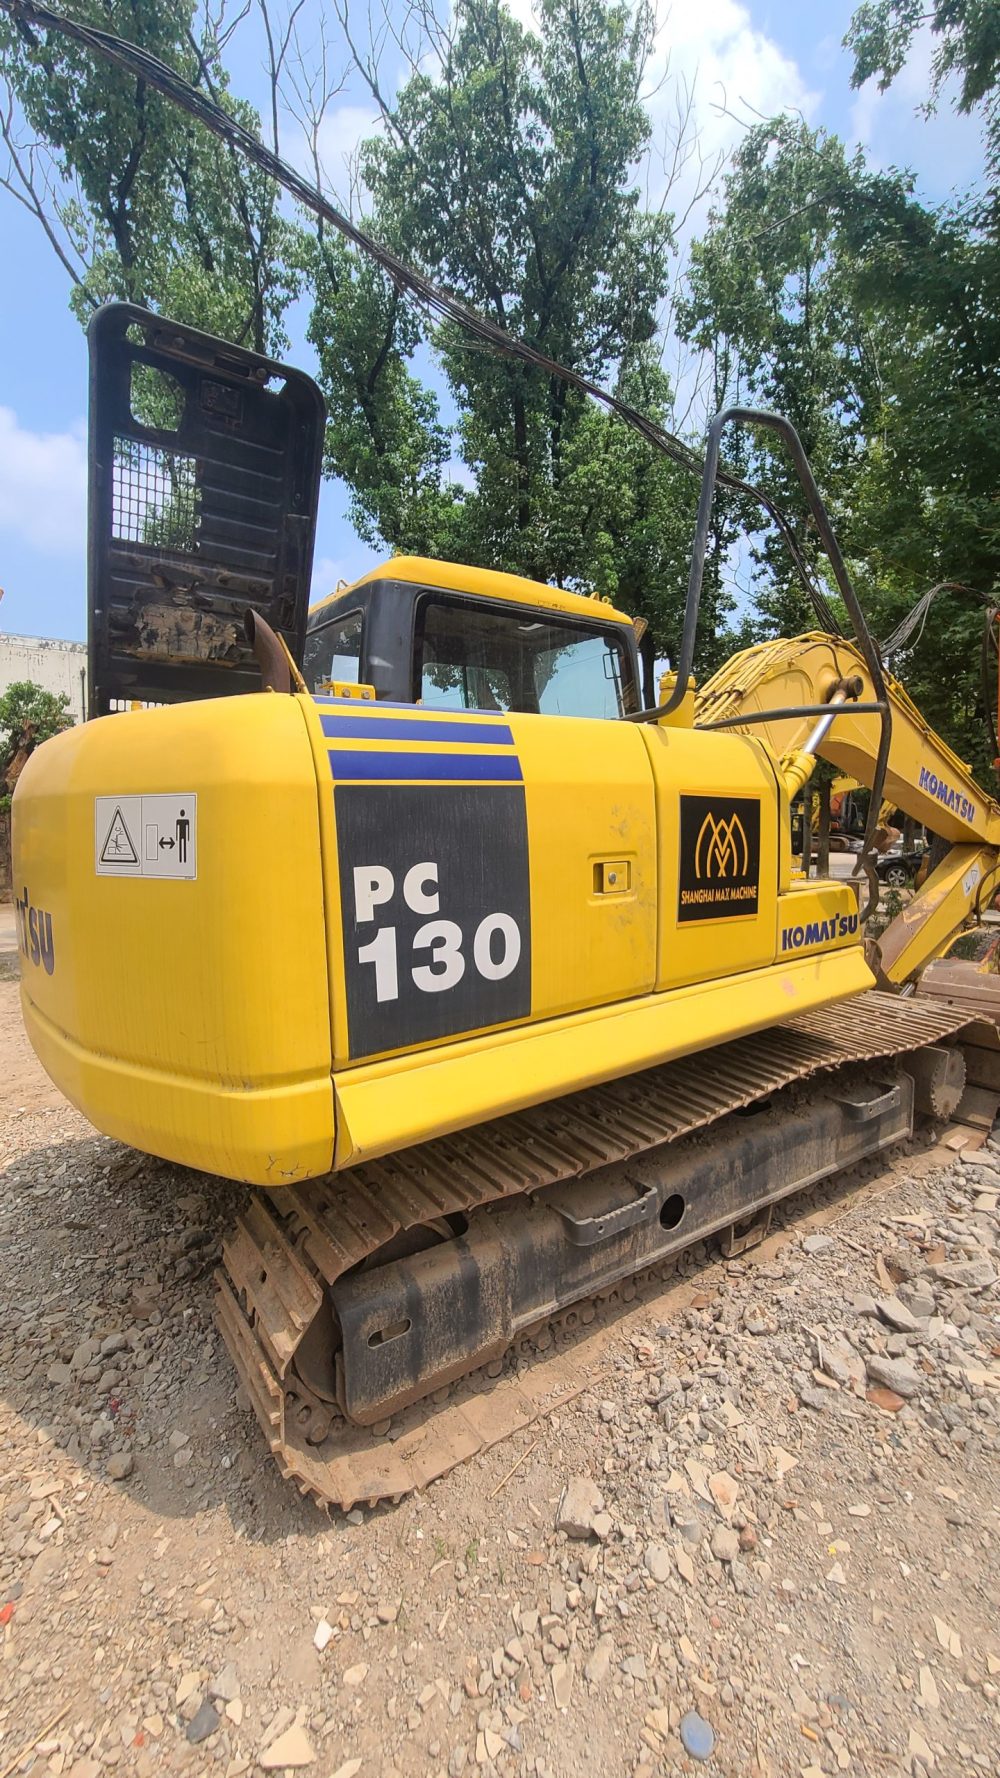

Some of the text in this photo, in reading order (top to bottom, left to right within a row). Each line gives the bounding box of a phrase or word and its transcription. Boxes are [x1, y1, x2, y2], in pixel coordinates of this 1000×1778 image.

[919, 766, 975, 823] KOMATSU
[353, 862, 440, 922] PC
[681, 885, 757, 905] SHANGHAI MAX MACHINE
[16, 886, 55, 976] TSU
[358, 912, 521, 1003] 130
[782, 912, 858, 951] KOMATSU
